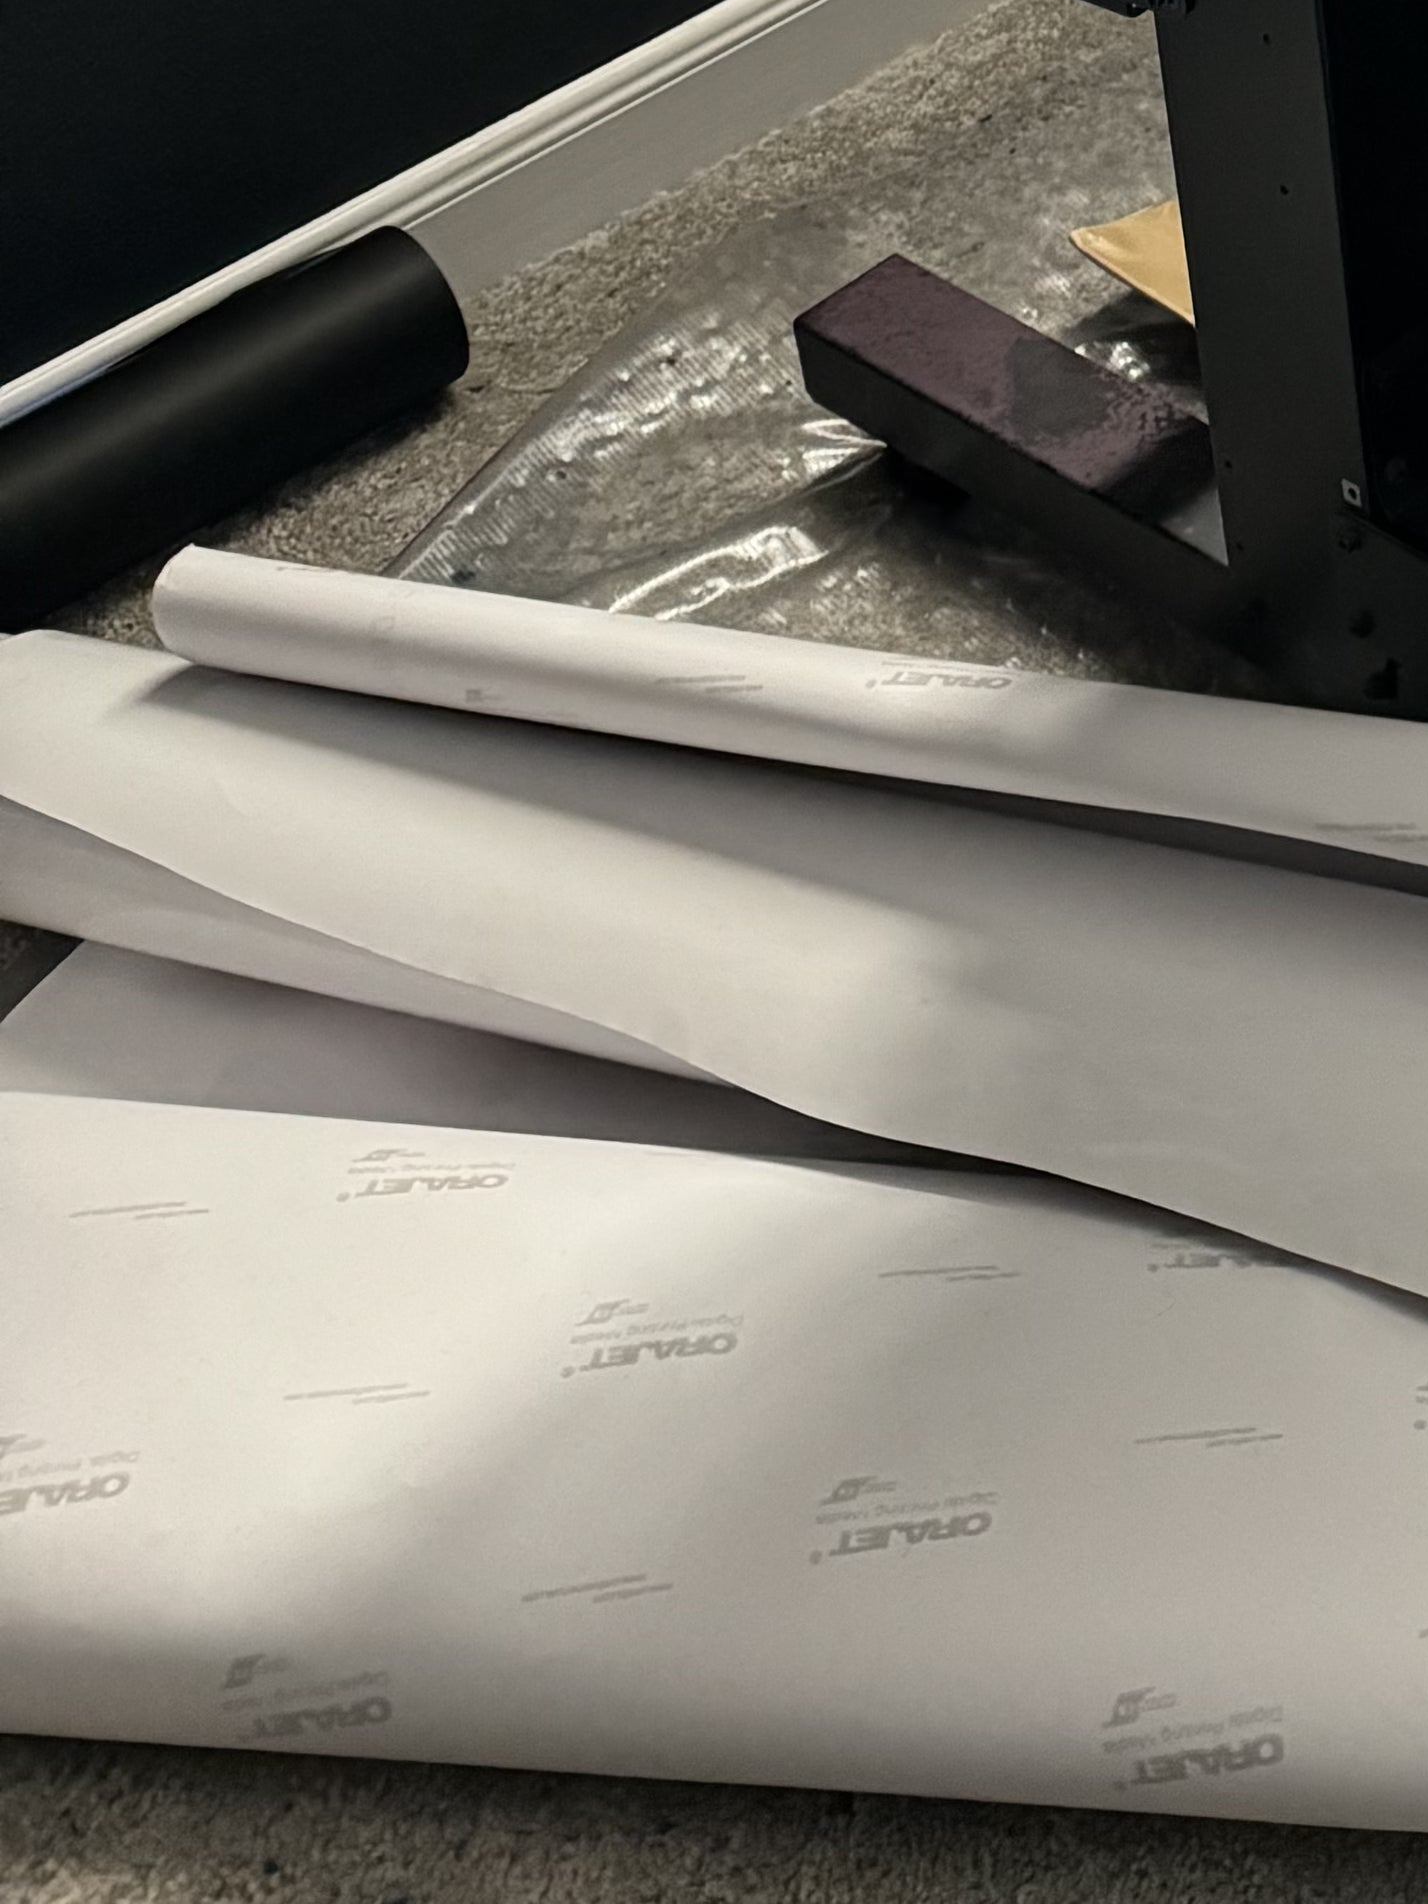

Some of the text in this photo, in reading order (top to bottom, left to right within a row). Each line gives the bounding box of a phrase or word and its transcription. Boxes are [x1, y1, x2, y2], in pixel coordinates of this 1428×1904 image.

[578, 1333, 738, 1372] ORAJET
[0, 1472, 131, 1517] ORAJE
[829, 1512, 992, 1556] ORAJET
[1131, 1734, 1284, 1785] ORAJET
